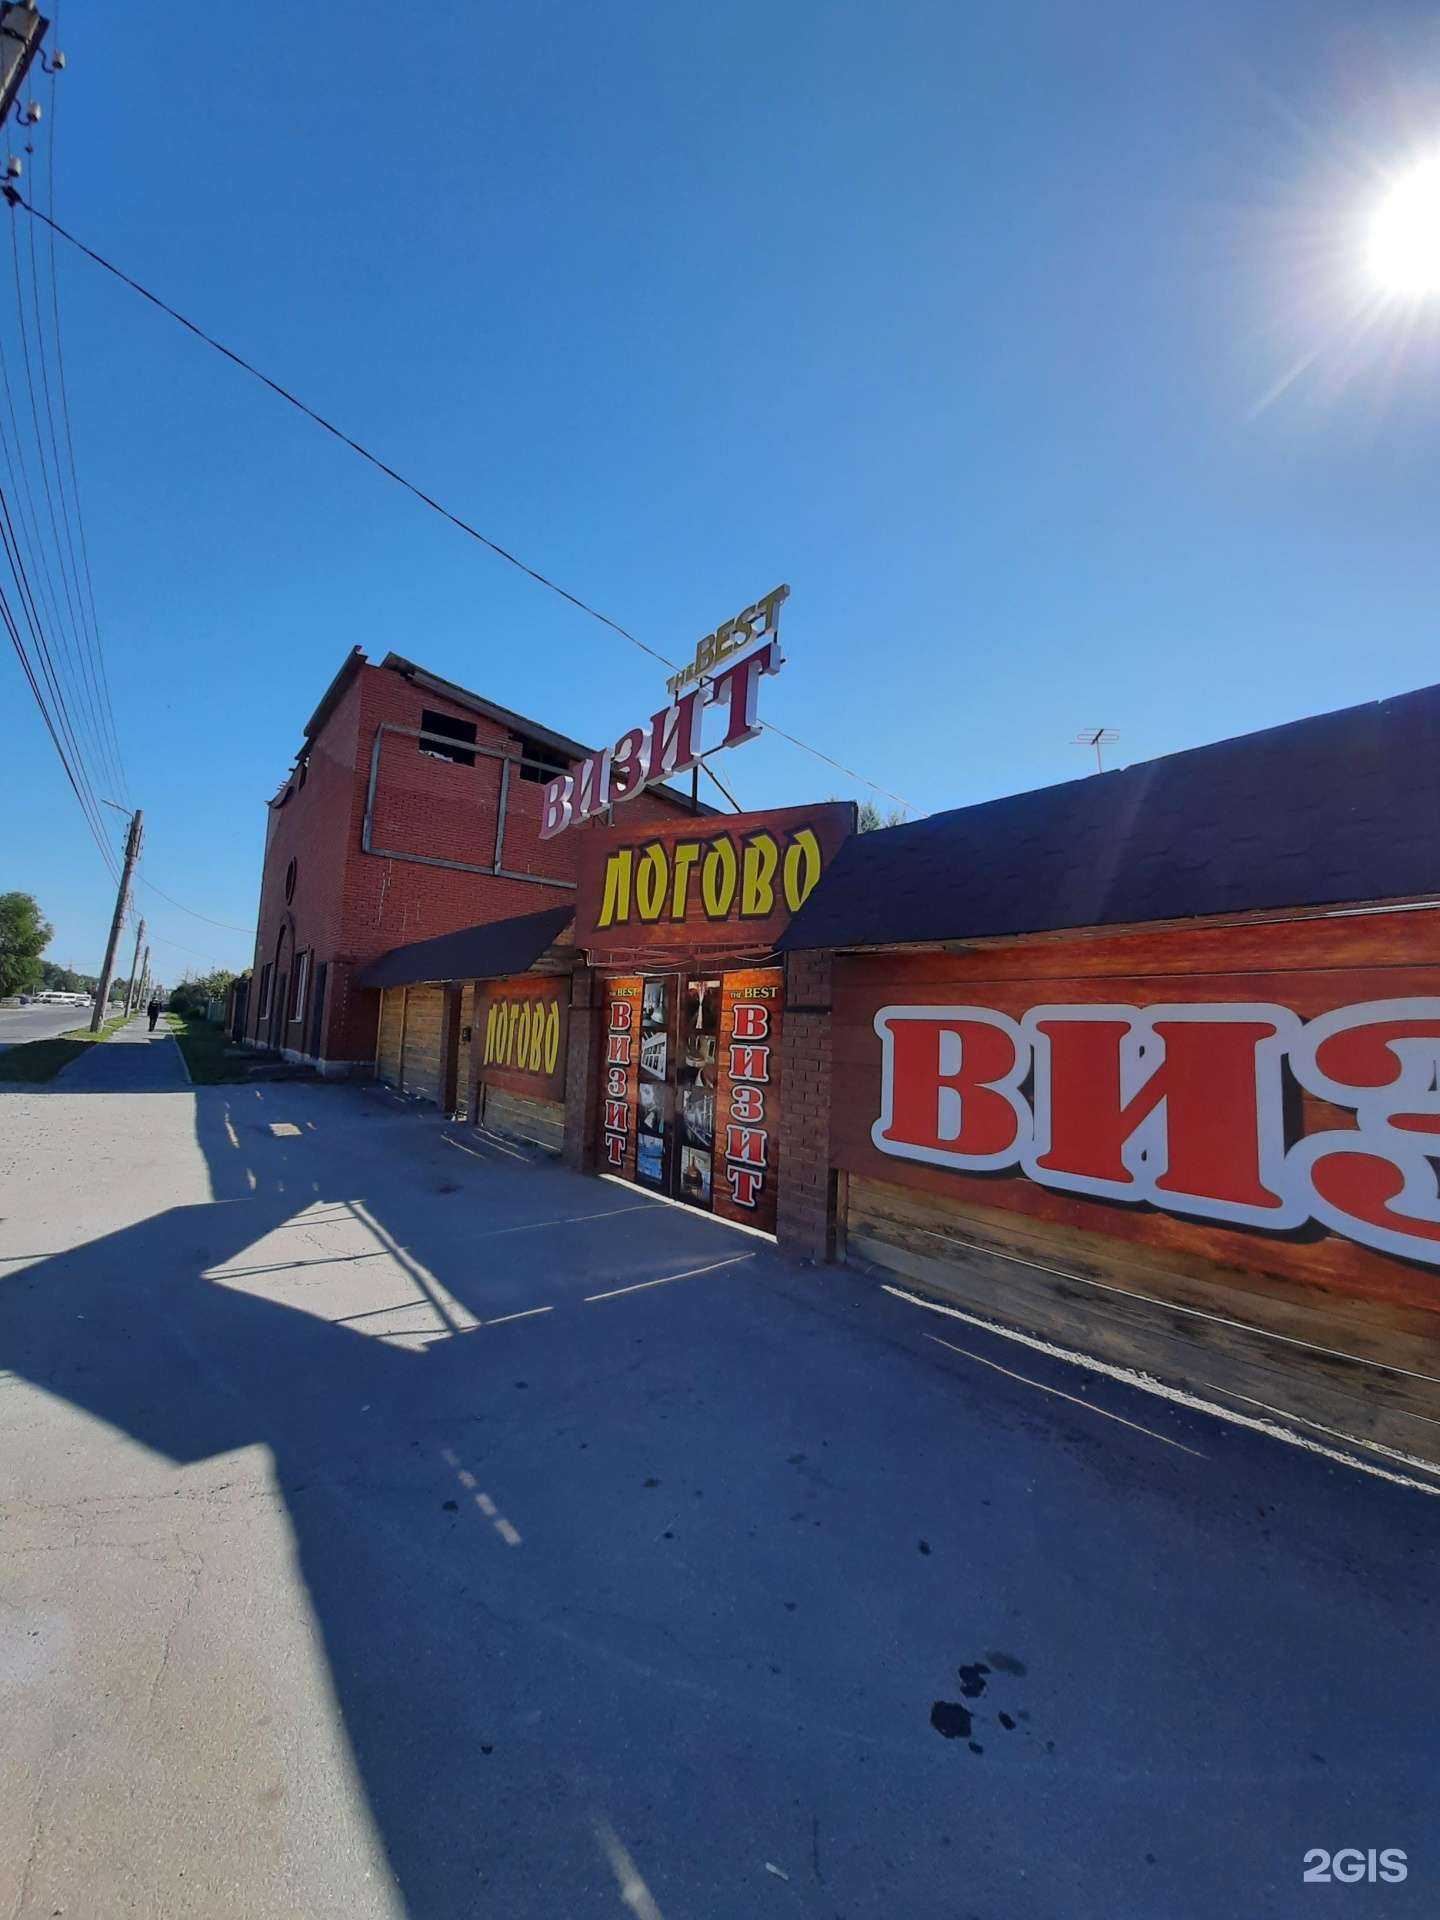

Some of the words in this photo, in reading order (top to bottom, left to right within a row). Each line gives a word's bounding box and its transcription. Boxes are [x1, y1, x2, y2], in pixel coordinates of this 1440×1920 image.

[695, 583, 790, 675] BEST
[539, 642, 781, 840] ВИЗИТ
[597, 827, 822, 928] ЛОГОВО
[484, 999, 560, 1074] ЛОГОВО
[744, 986, 778, 999] BEST
[604, 1001, 631, 1165] ВИЗИТ
[725, 1004, 769, 1207] ВИЗИТ
